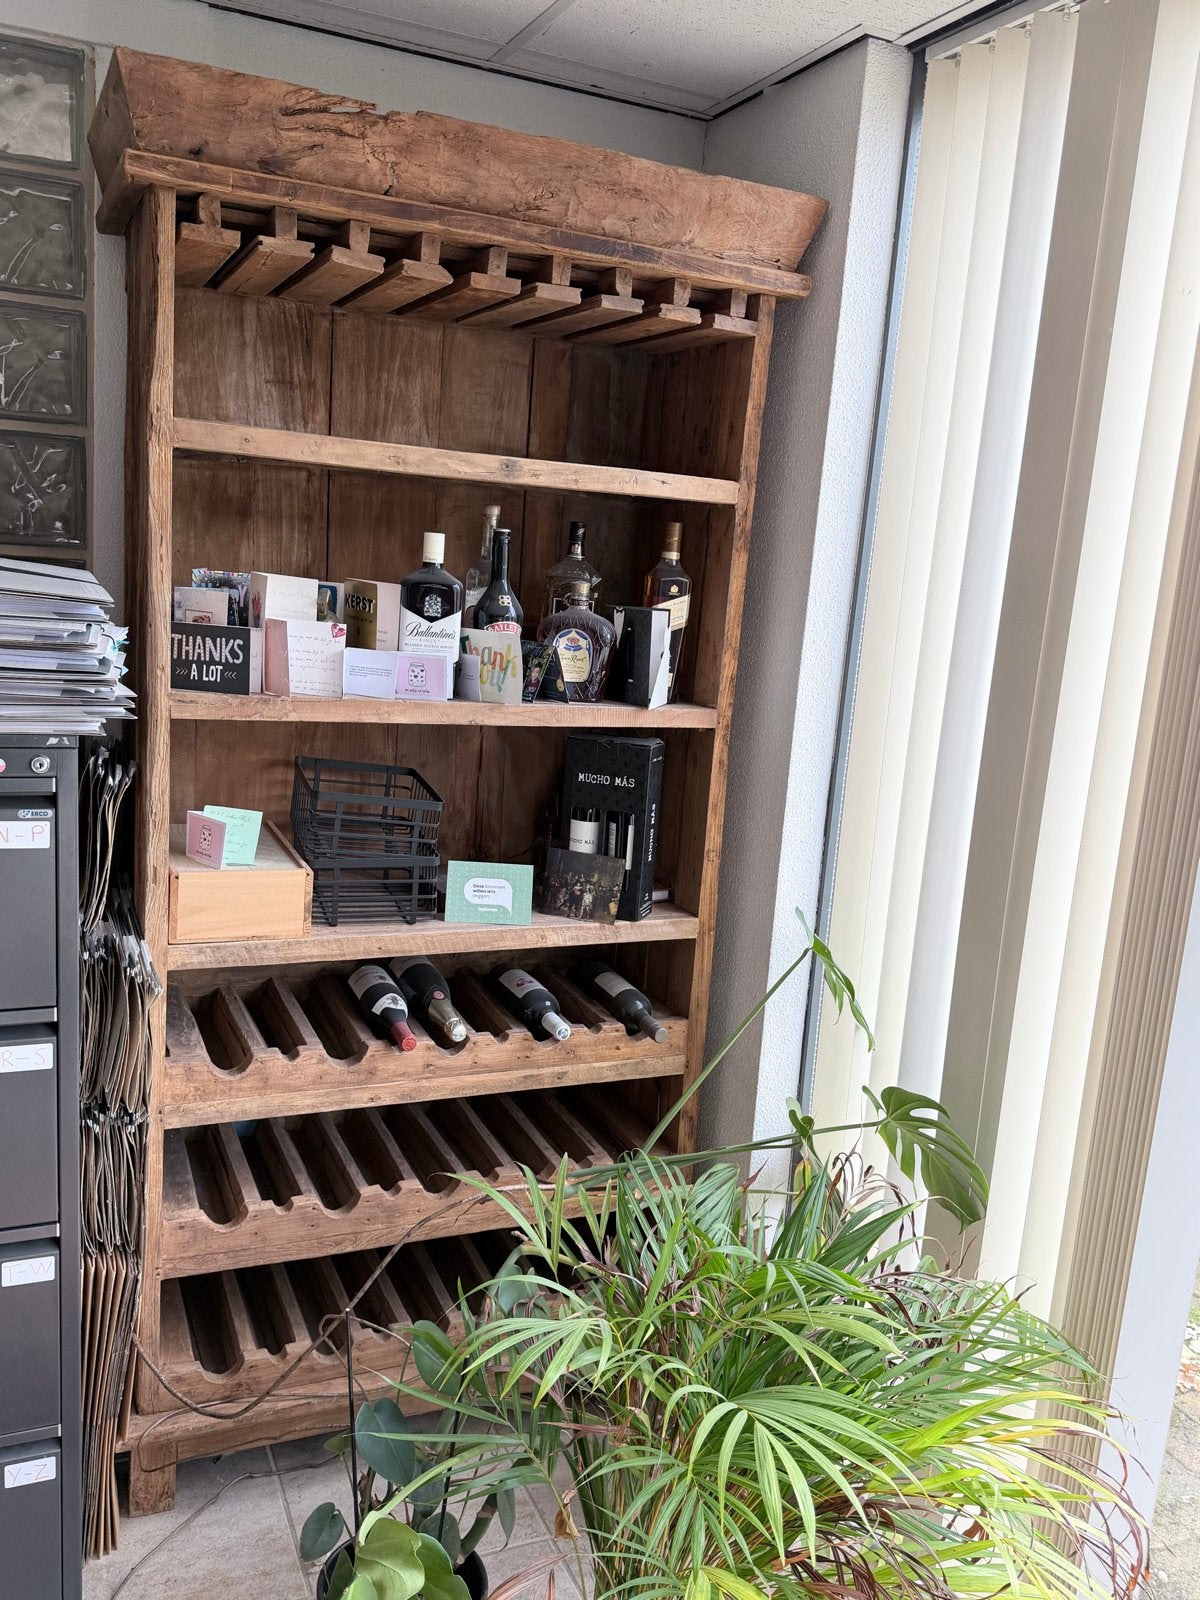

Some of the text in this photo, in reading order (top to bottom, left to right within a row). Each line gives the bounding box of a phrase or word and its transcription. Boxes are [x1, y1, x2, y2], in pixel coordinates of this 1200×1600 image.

[345, 593, 374, 613] KERST
[404, 621, 456, 640] Ballantine's
[171, 633, 244, 664] THANKS
[460, 635, 518, 678] Thank
[190, 663, 223, 682] A LOT
[480, 660, 511, 693] ou!
[578, 772, 635, 788] MUCHO MÁS
